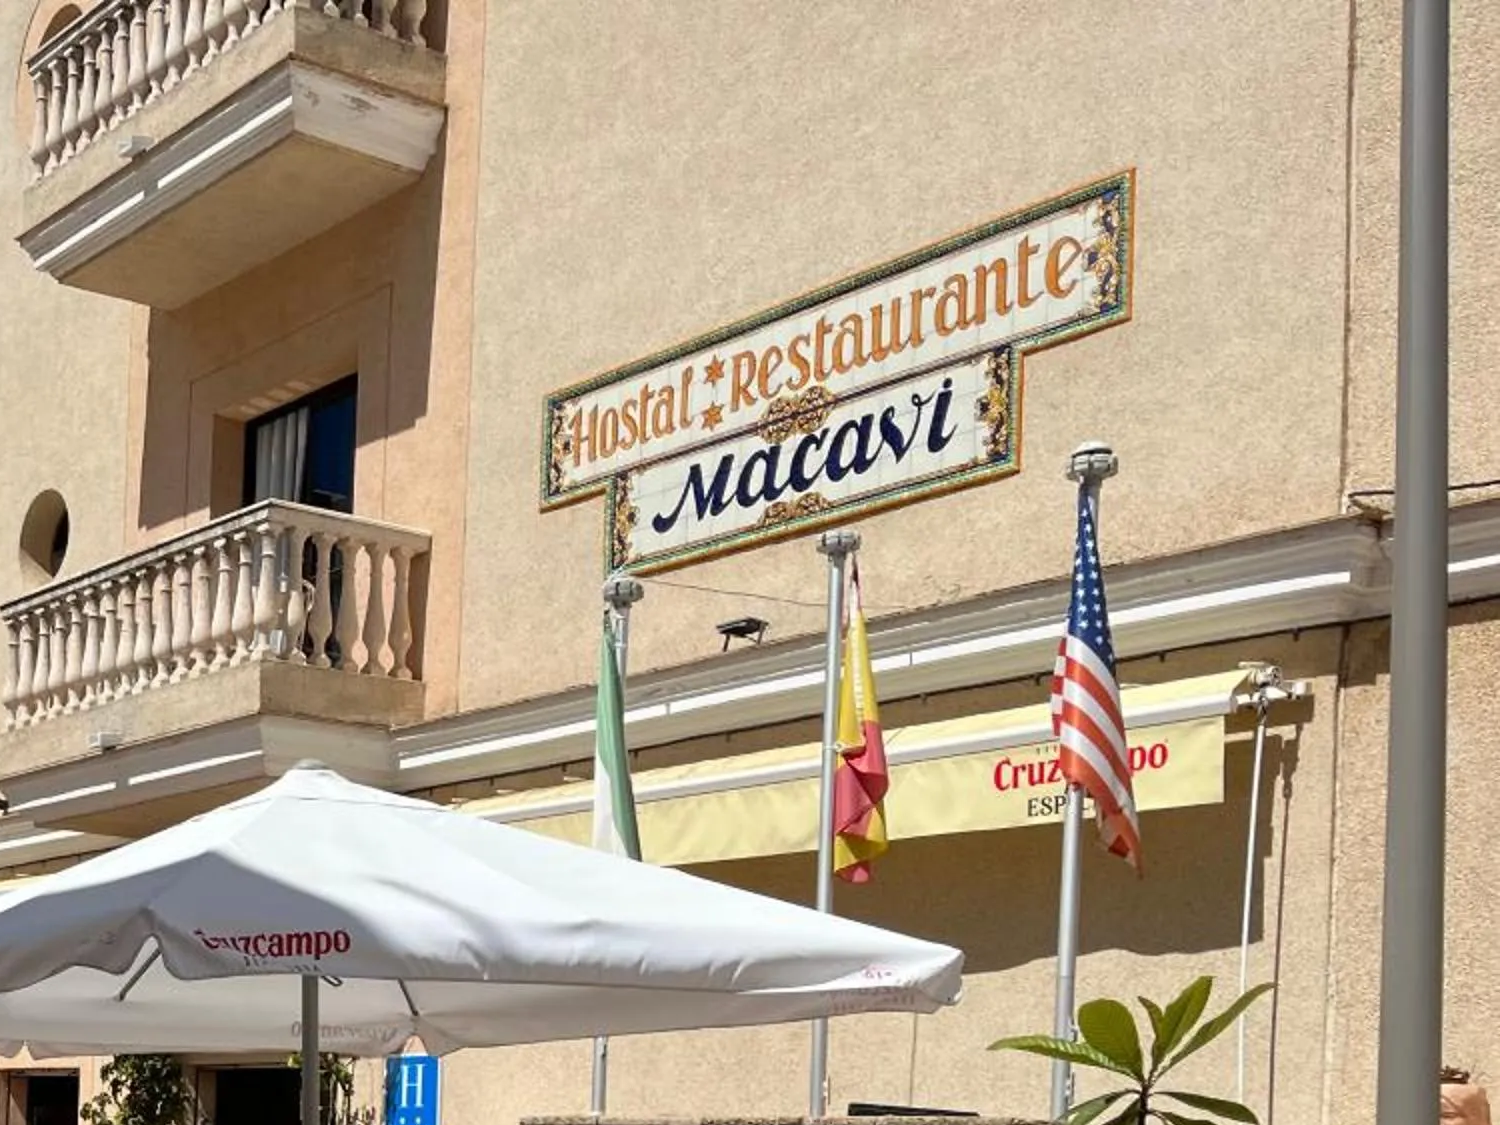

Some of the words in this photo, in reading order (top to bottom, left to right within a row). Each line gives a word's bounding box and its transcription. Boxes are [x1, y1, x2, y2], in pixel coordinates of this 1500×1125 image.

[569, 364, 695, 468] Hostal
[728, 234, 1086, 413] Restaurante
[652, 377, 959, 534] Macavi
[993, 742, 1169, 791] Cruzpo
